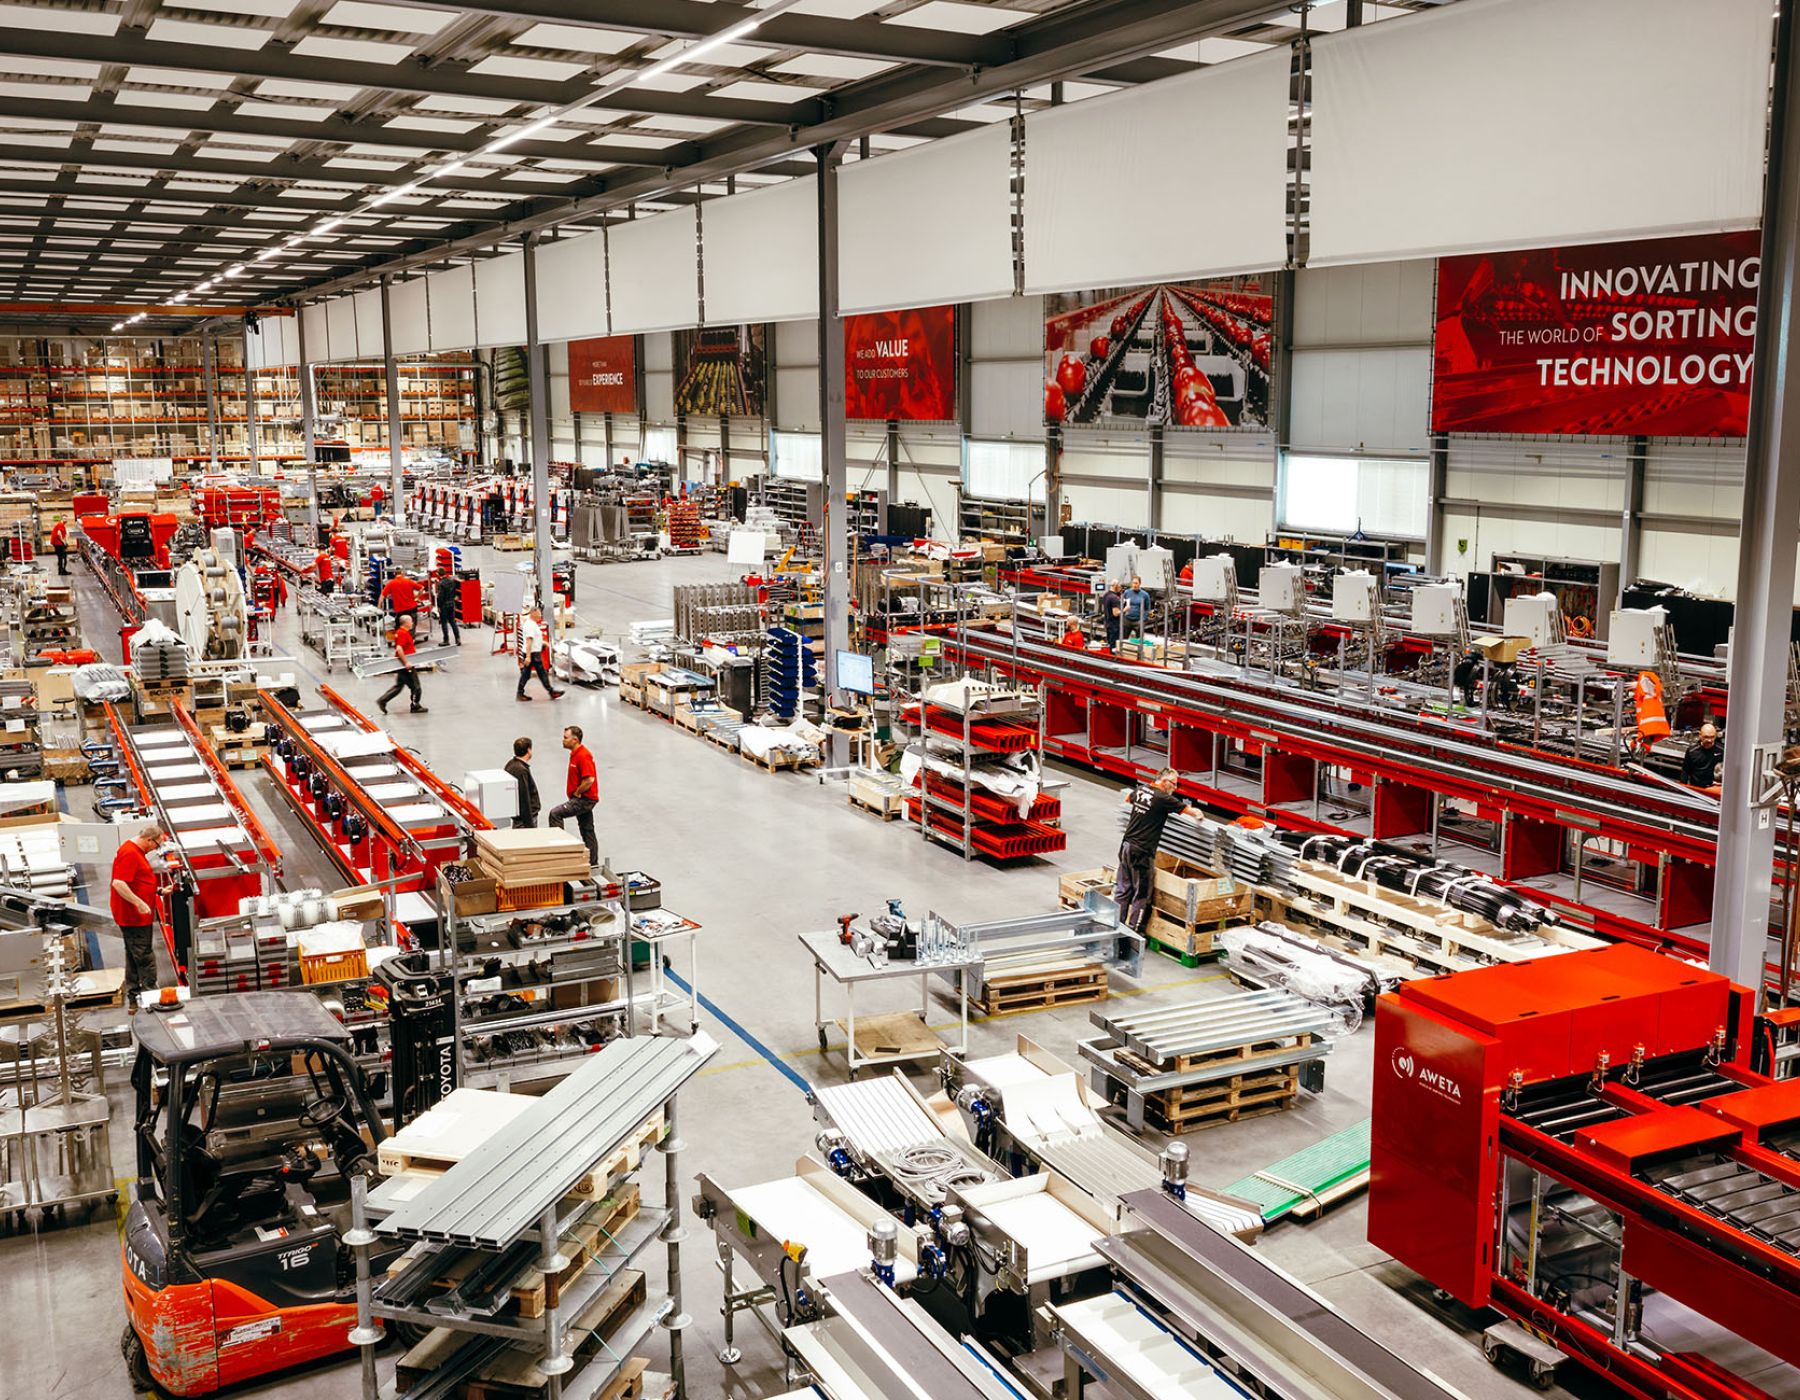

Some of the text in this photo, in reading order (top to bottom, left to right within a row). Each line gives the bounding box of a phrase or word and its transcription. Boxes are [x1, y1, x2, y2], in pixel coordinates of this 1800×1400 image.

[1560, 257, 1760, 300] INNOVATING
[1499, 305, 1757, 345] THE WORLD OF SORTING
[875, 339, 908, 357] VALUE
[1536, 353, 1754, 386] TECHNOLOGY
[1761, 814, 1767, 823] H
[1419, 1067, 1461, 1099] AWETA
[126, 1240, 147, 1281] OTA
[280, 1252, 310, 1271] 16
